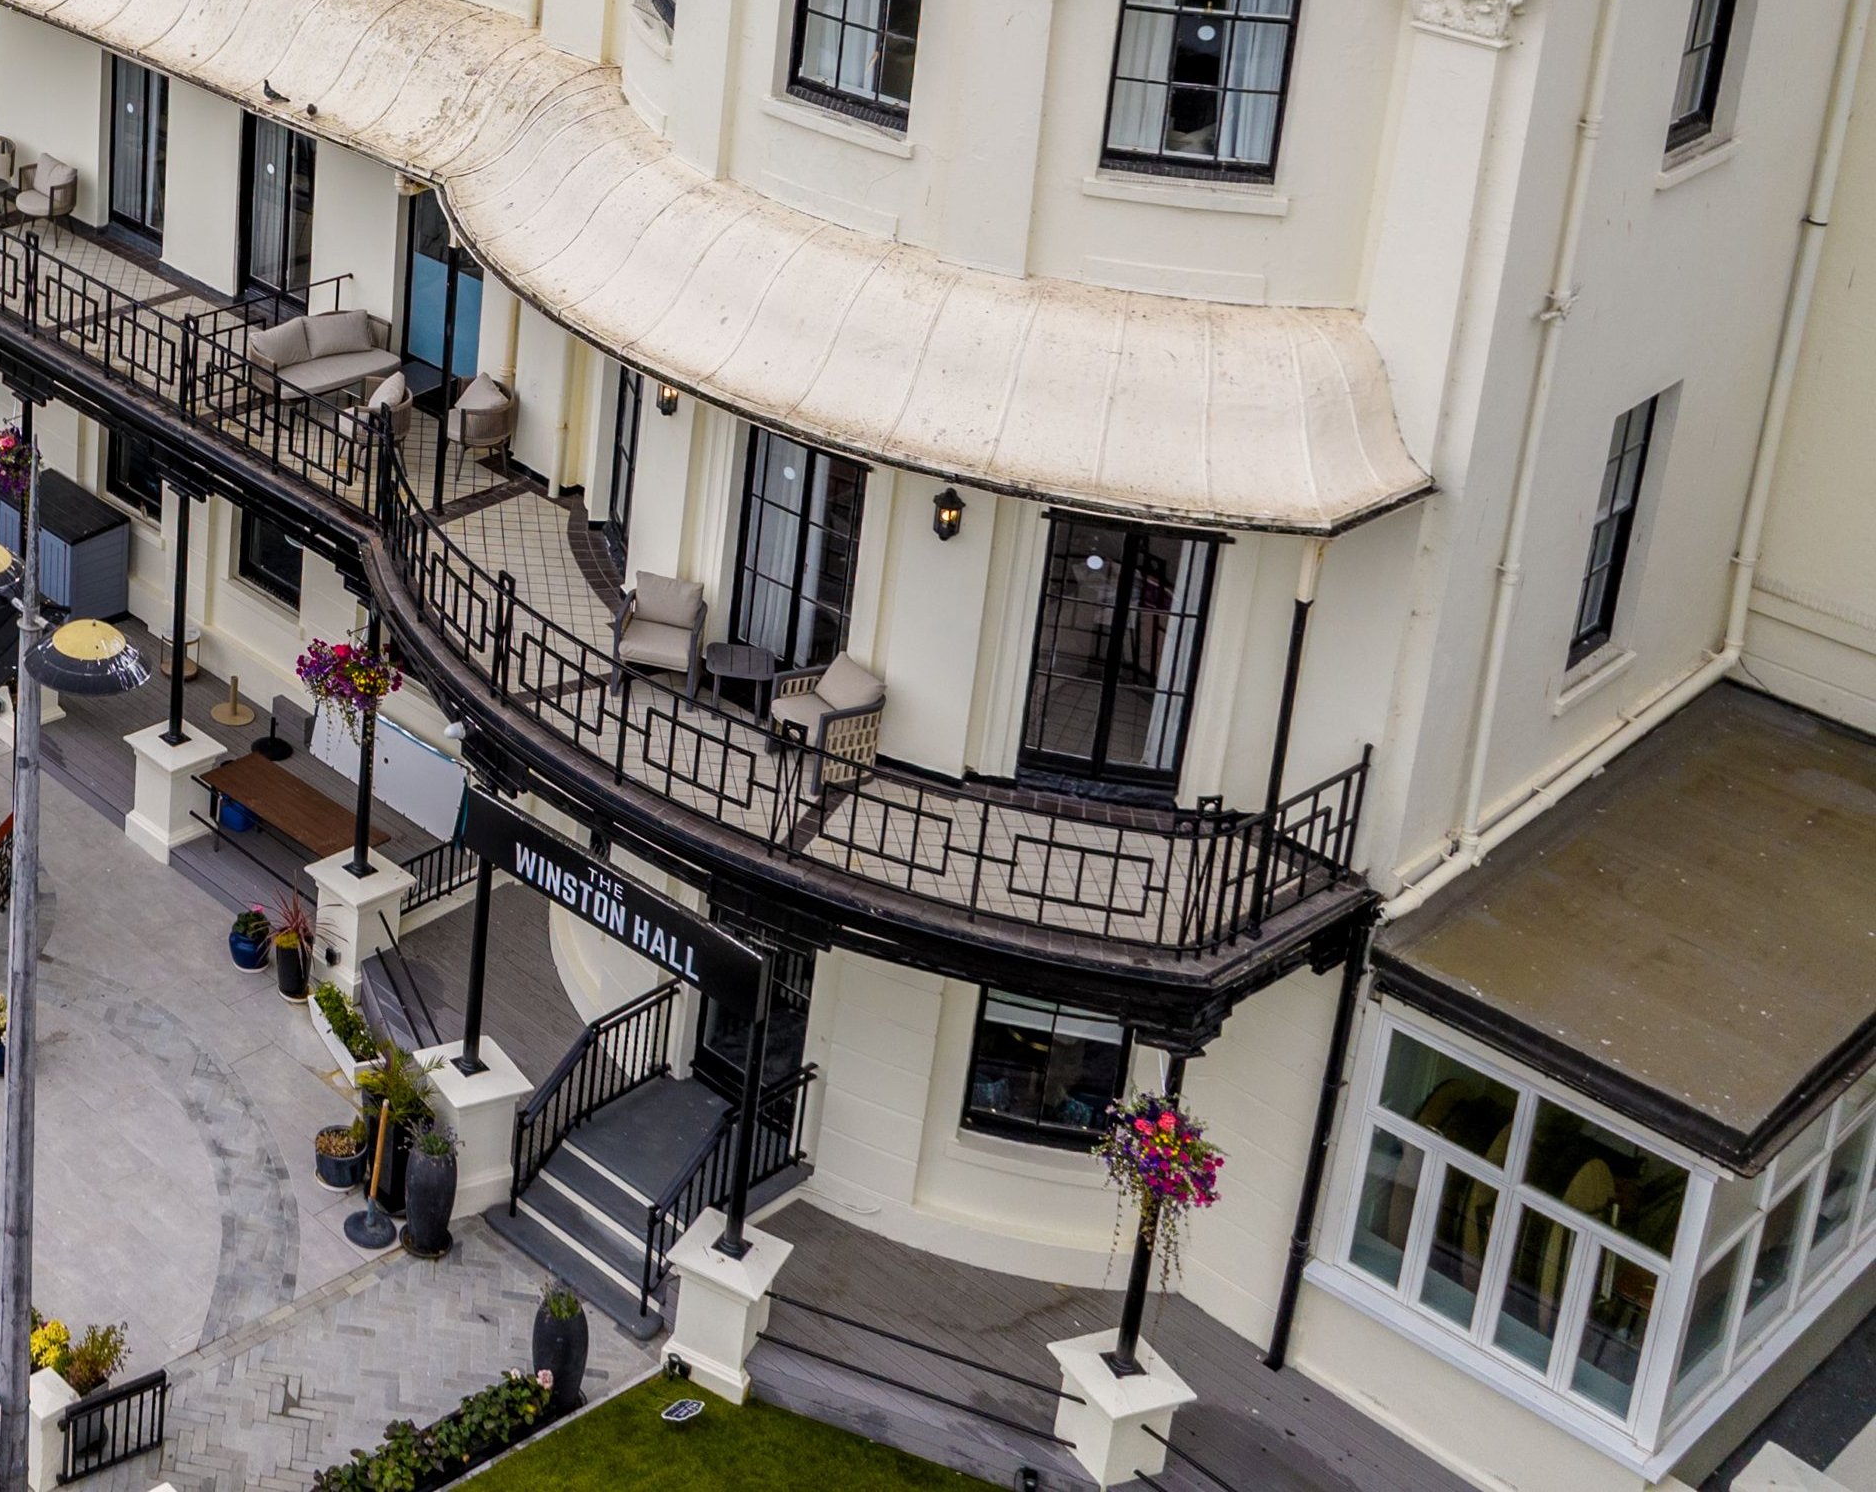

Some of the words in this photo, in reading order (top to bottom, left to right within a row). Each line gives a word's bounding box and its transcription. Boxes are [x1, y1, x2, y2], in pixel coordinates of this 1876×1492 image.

[516, 842, 626, 936] WINSTON
[632, 914, 700, 982] HALL
[588, 867, 623, 901] THE
